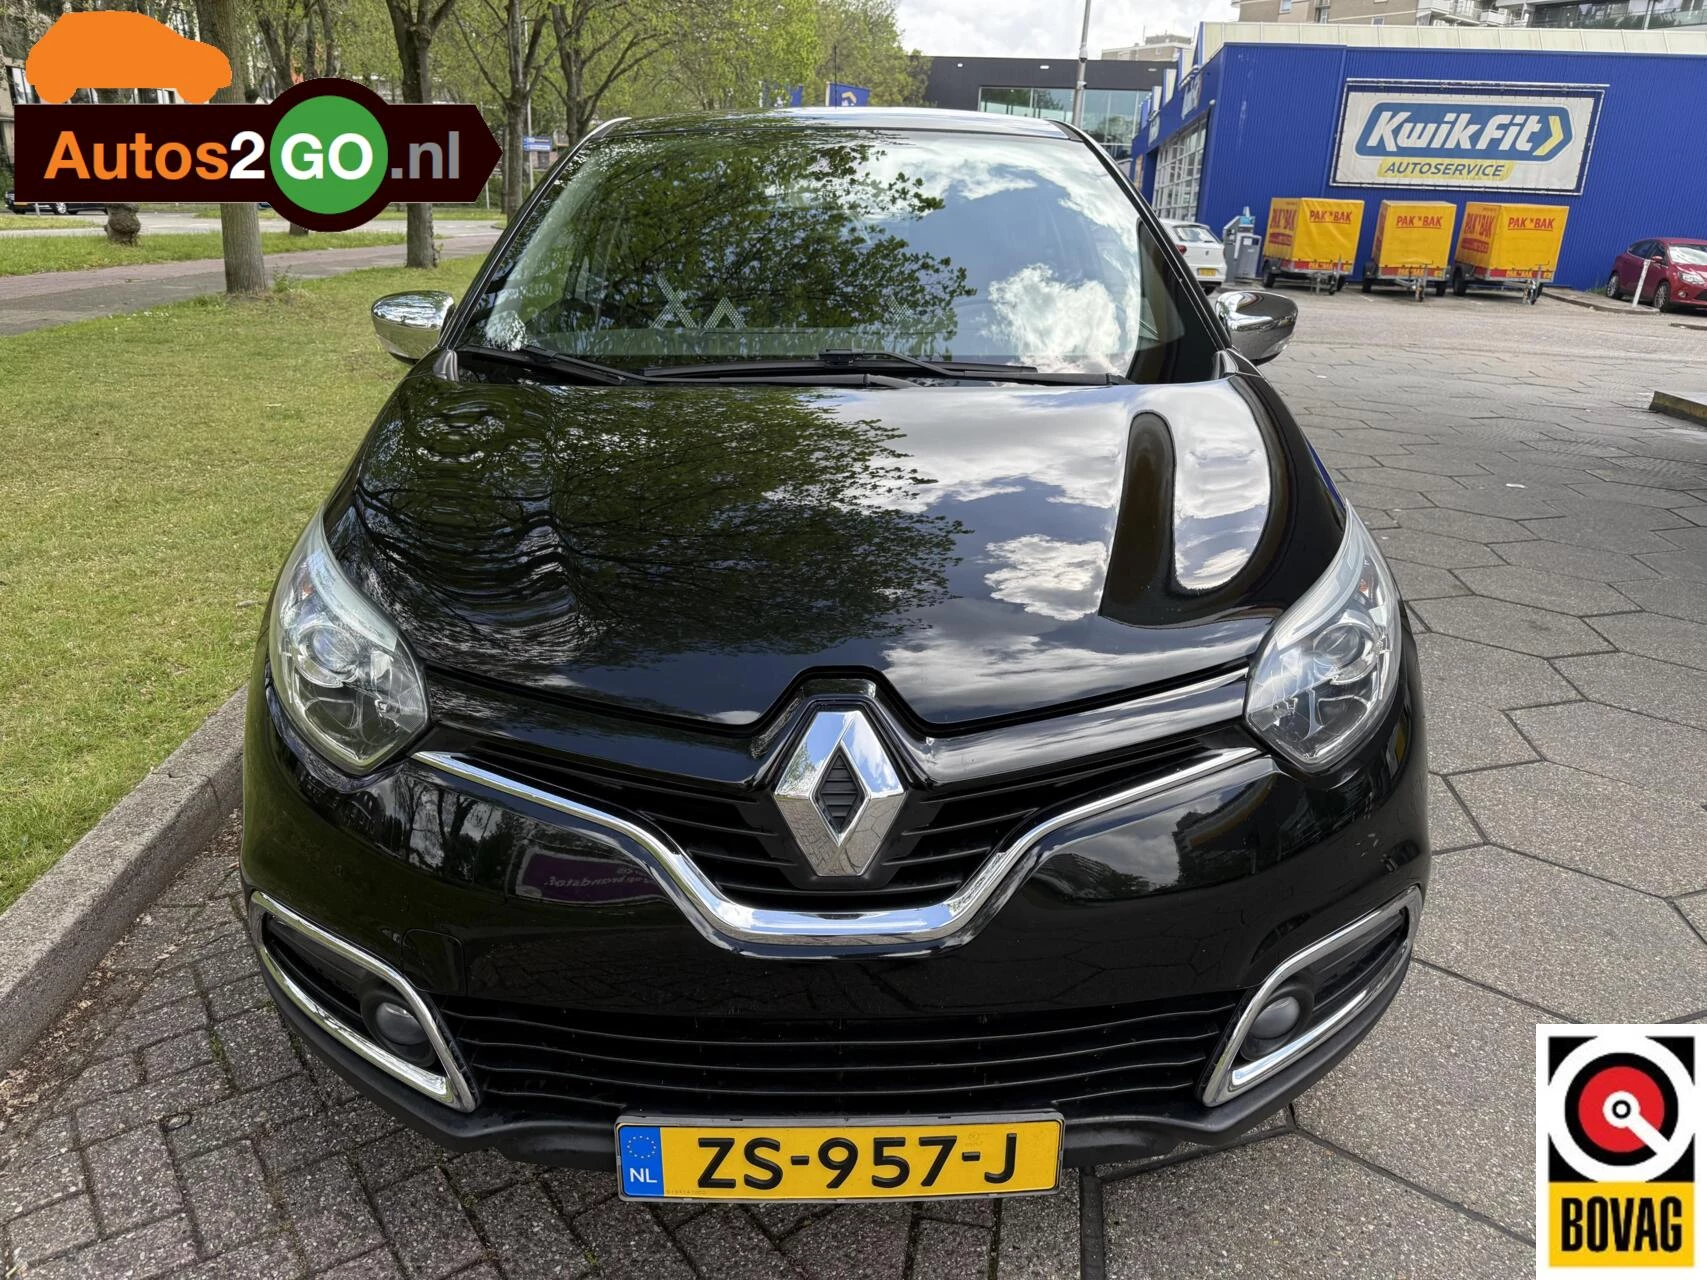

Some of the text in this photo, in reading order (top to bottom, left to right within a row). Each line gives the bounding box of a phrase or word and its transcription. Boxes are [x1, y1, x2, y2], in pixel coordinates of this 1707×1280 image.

[1384, 162, 1505, 177] AUTOSERVICE
[697, 1133, 1017, 1190] ZS-957-J
[629, 1167, 658, 1184] NL
